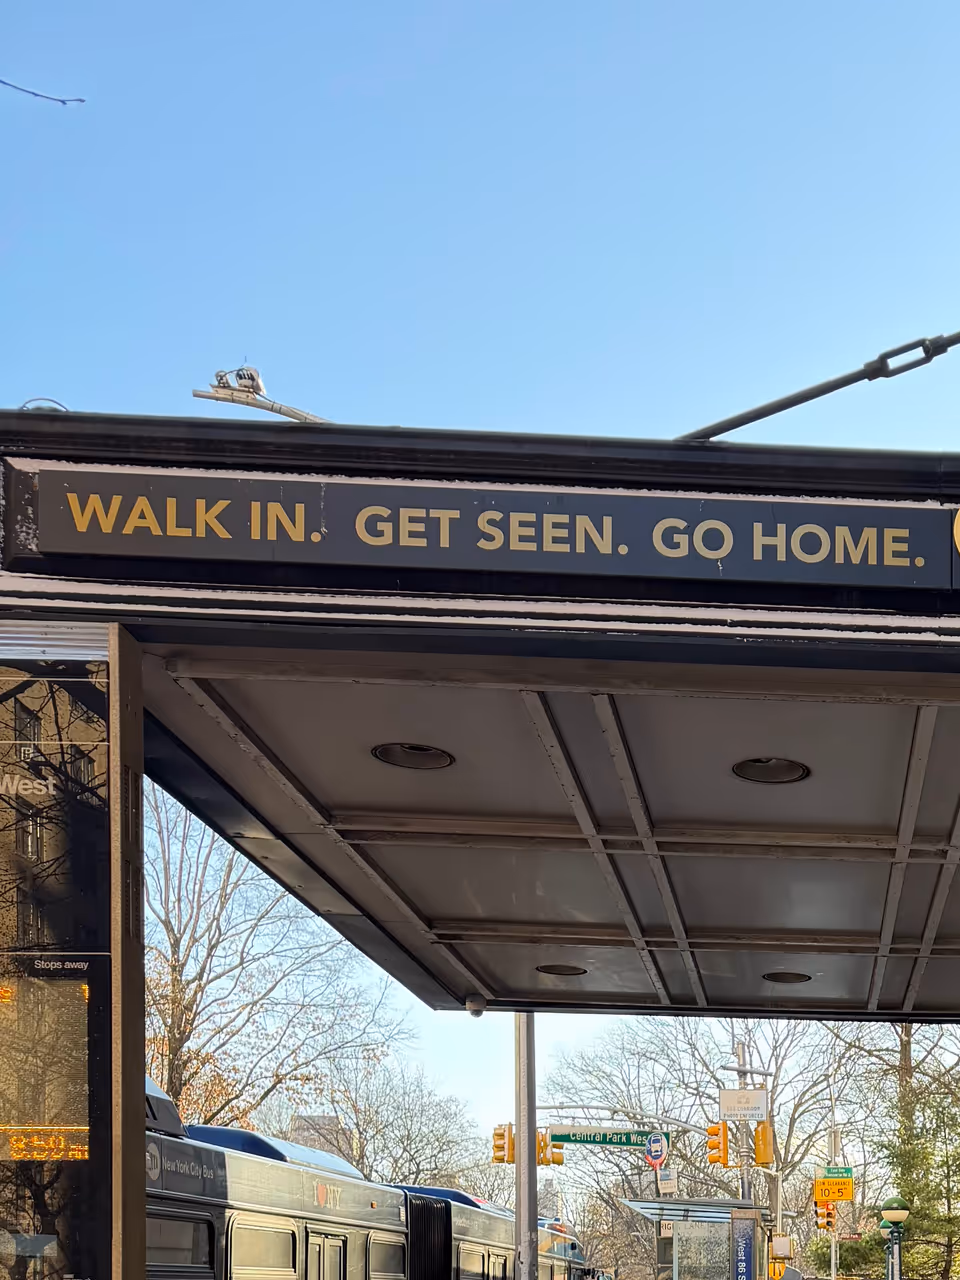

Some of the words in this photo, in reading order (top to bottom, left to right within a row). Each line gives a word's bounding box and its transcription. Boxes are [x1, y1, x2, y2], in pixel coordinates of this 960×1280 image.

[66, 493, 232, 540] WALK
[251, 502, 322, 543] IN.
[356, 507, 460, 548] GET
[477, 512, 629, 555] SEEN.
[653, 520, 732, 558] GO
[753, 525, 925, 568] HOME.
[34, 960, 62, 970] Stops
[64, 961, 89, 971] away
[570, 1132, 603, 1141] Central
[606, 1133, 627, 1143] Park
[630, 1134, 648, 1144] Wes
[162, 1156, 176, 1172] New
[176, 1160, 190, 1175] York
[190, 1162, 203, 1180] City
[202, 1165, 214, 1179] Bus
[737, 1237, 746, 1260] West
[737, 1262, 746, 1273] 86
